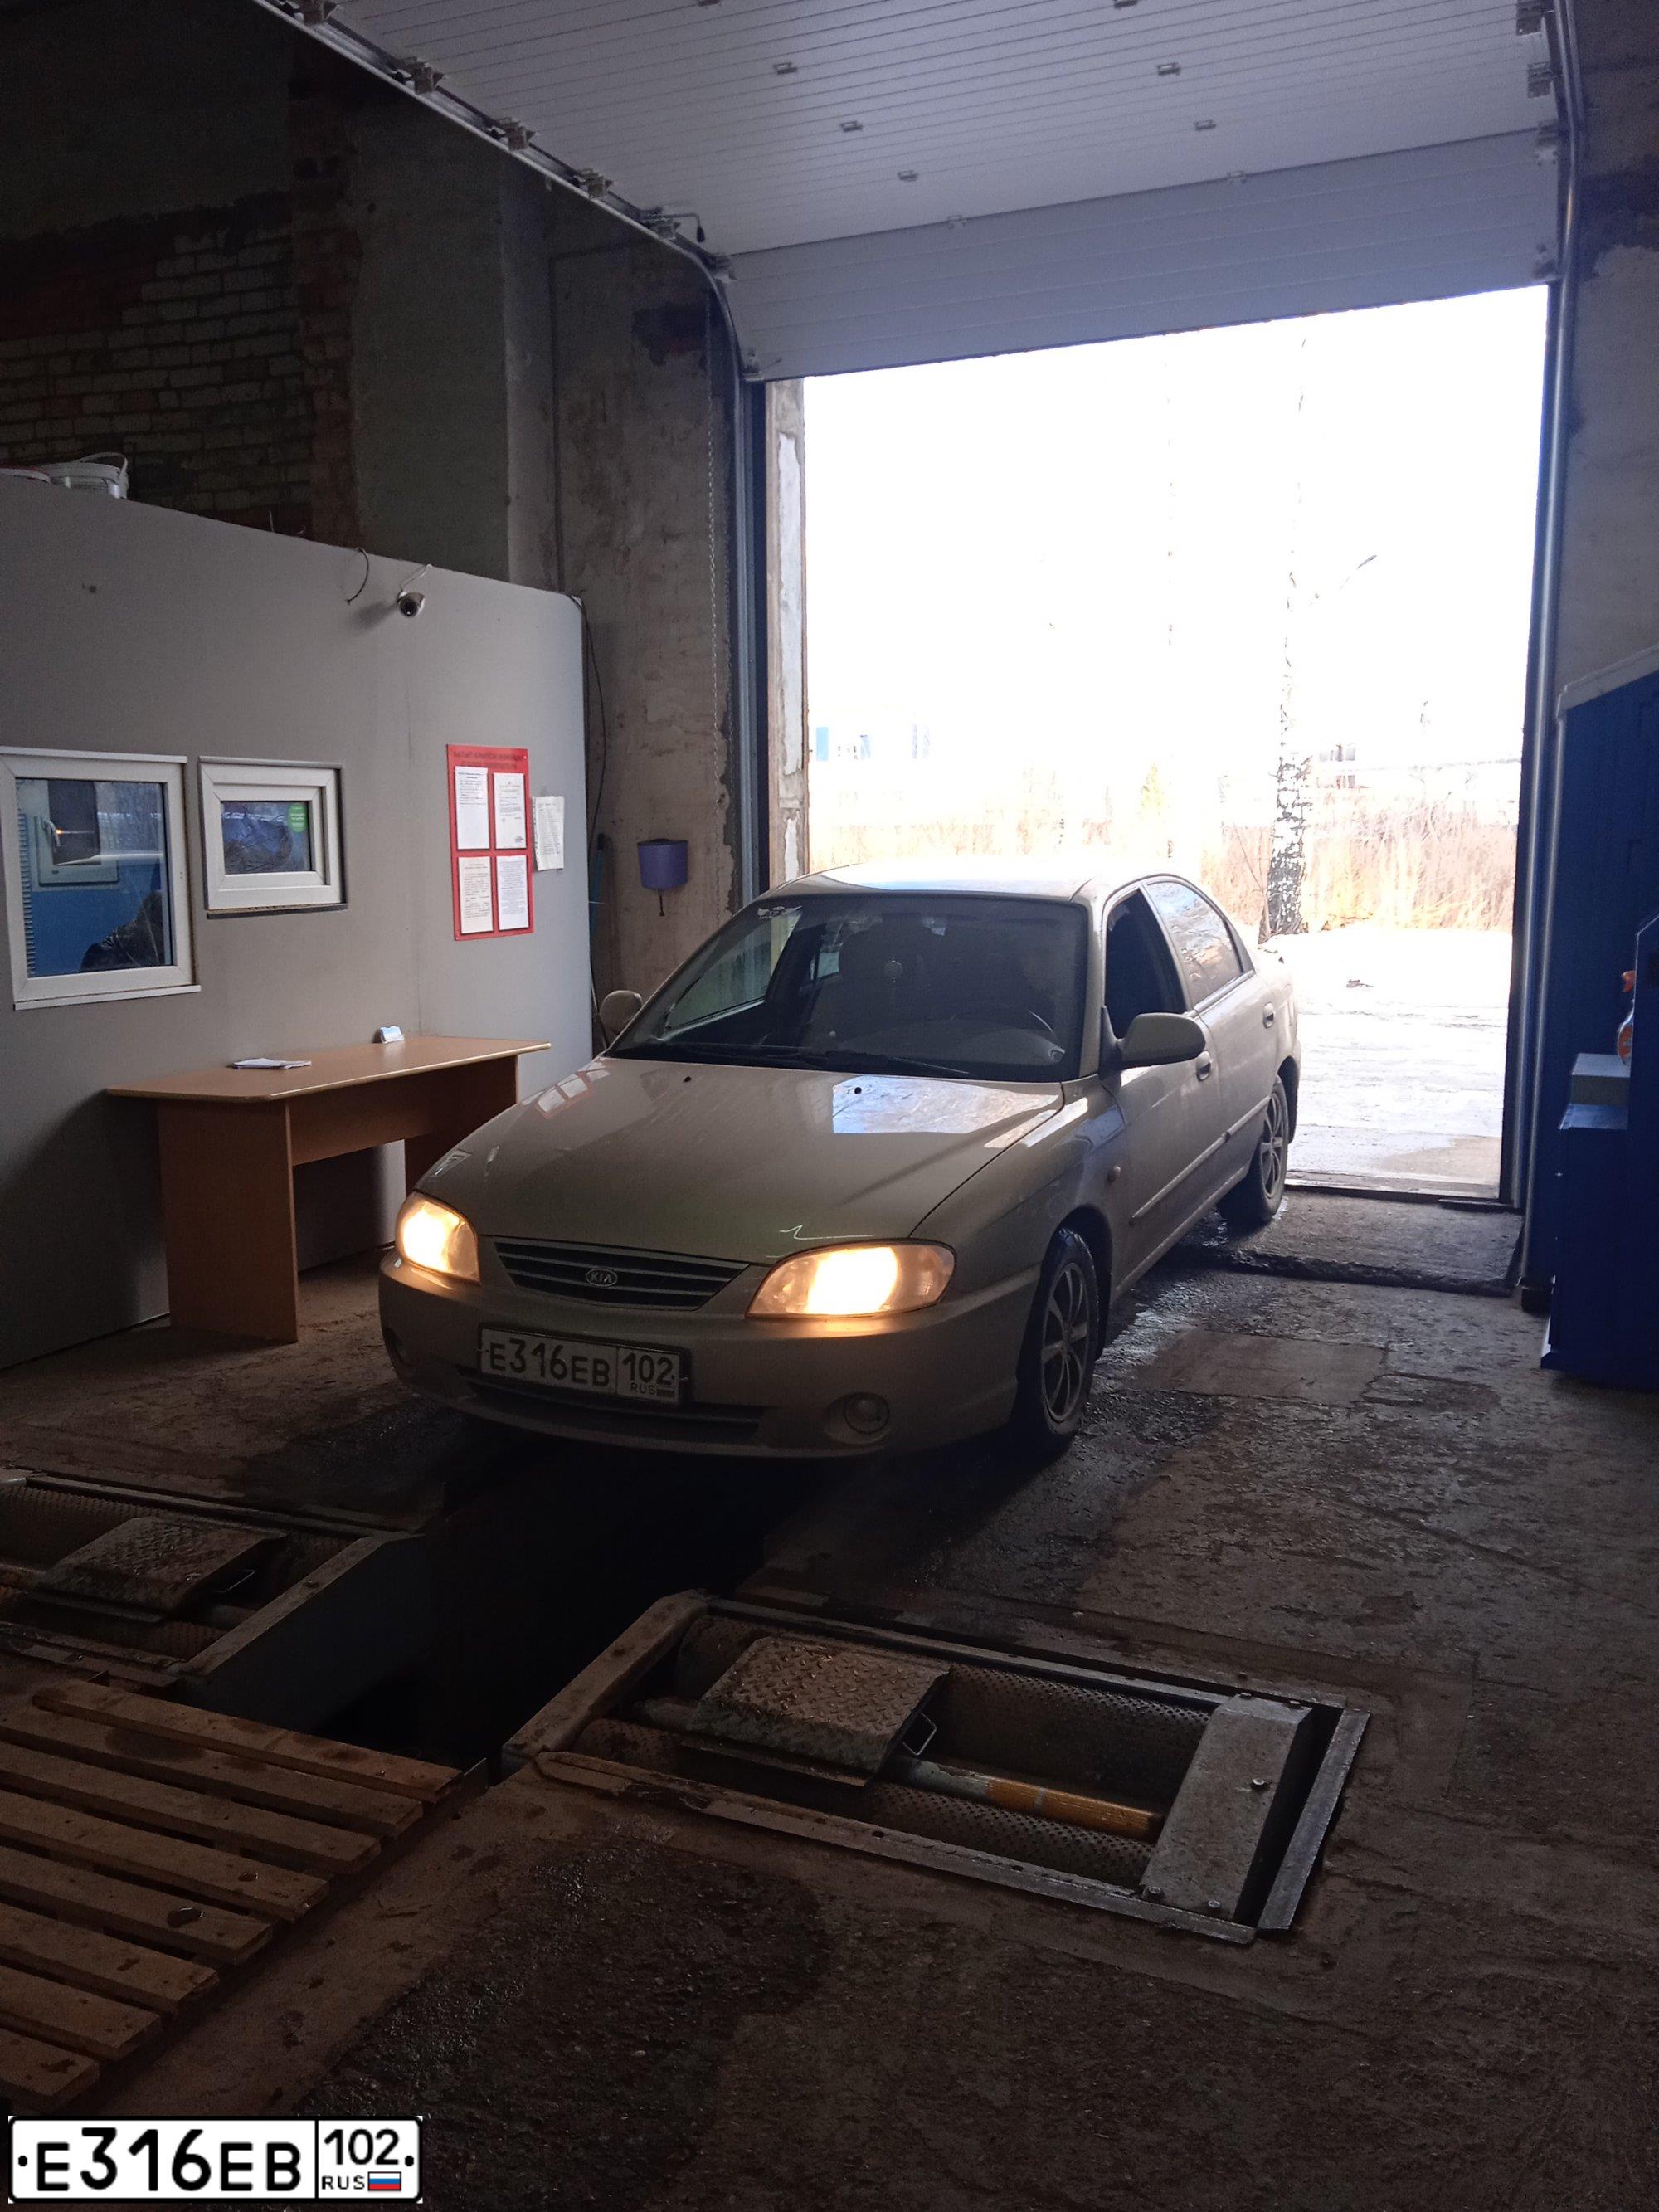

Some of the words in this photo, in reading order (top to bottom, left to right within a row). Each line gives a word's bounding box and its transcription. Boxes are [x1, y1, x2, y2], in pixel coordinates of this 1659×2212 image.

[591, 1271, 612, 1284] KIA
[489, 1337, 611, 1387] E316EB
[622, 1352, 674, 1386] 102
[630, 1382, 656, 1396] RUS
